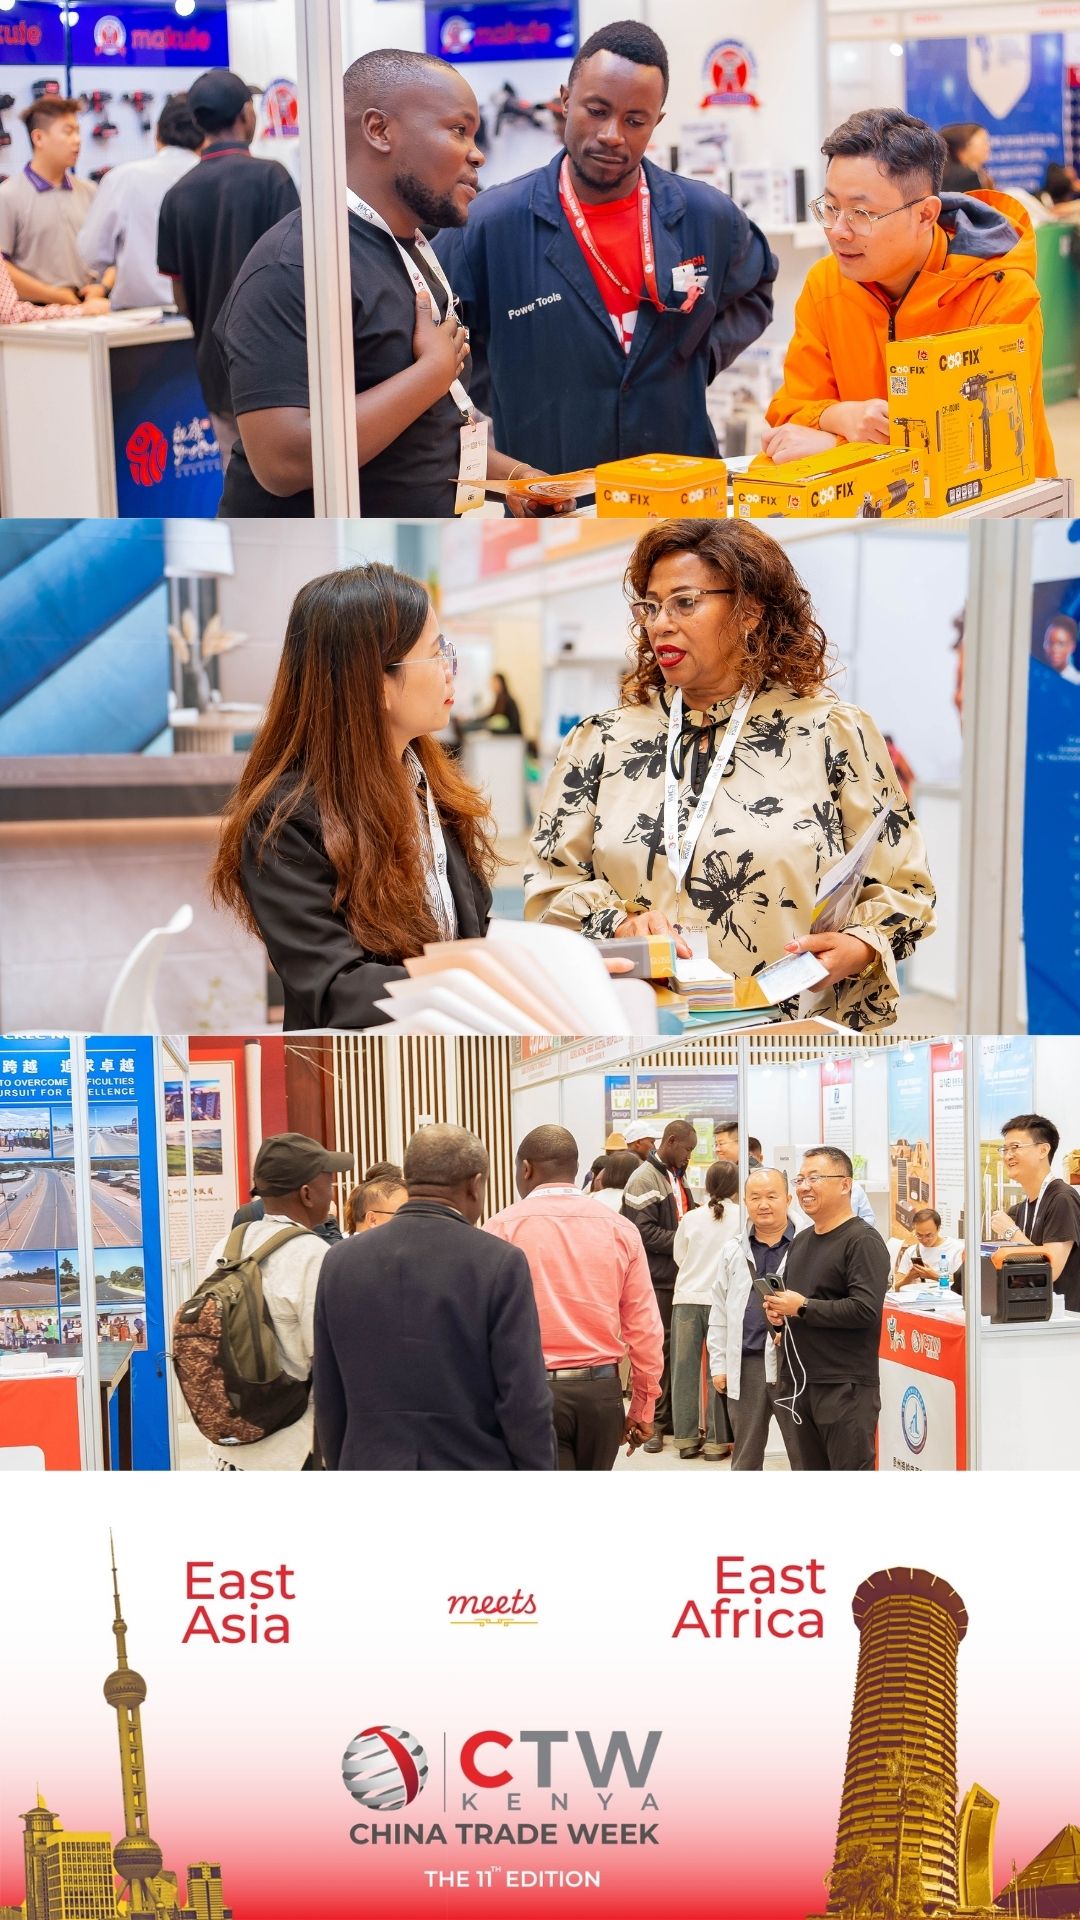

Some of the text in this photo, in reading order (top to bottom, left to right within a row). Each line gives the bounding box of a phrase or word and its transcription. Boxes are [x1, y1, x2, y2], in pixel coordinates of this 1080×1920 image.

[131, 26, 211, 51] makute
[508, 293, 562, 320] Power Tools
[939, 349, 980, 371] COOFIX
[890, 366, 925, 375] COOFIX
[604, 490, 650, 506] COOFIX
[681, 486, 719, 504] COOFIX
[738, 493, 777, 506] COOFIX
[811, 481, 854, 507] COOFIX
[14, 1078, 69, 1087] OVERCOME
[41, 1088, 62, 1096] FOR
[66, 1087, 135, 1096] EELLENCE
